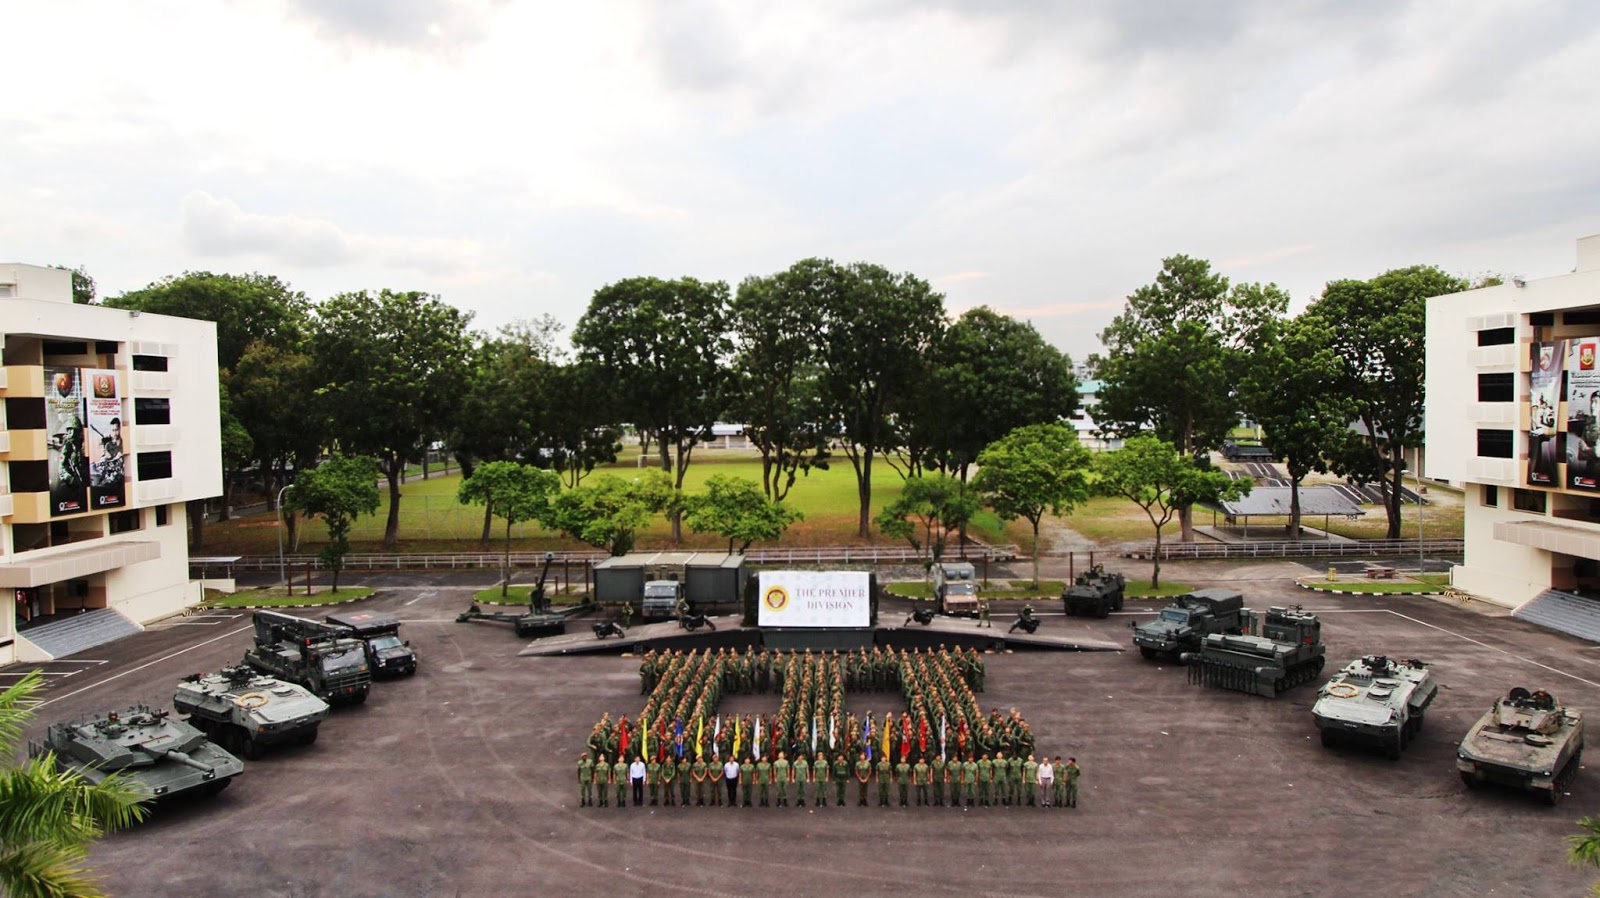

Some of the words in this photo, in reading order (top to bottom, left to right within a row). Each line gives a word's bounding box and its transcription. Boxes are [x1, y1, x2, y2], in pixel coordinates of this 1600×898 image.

[796, 588, 815, 598] THE
[819, 588, 865, 598] PREMIER
[807, 601, 853, 609] DIVISION
